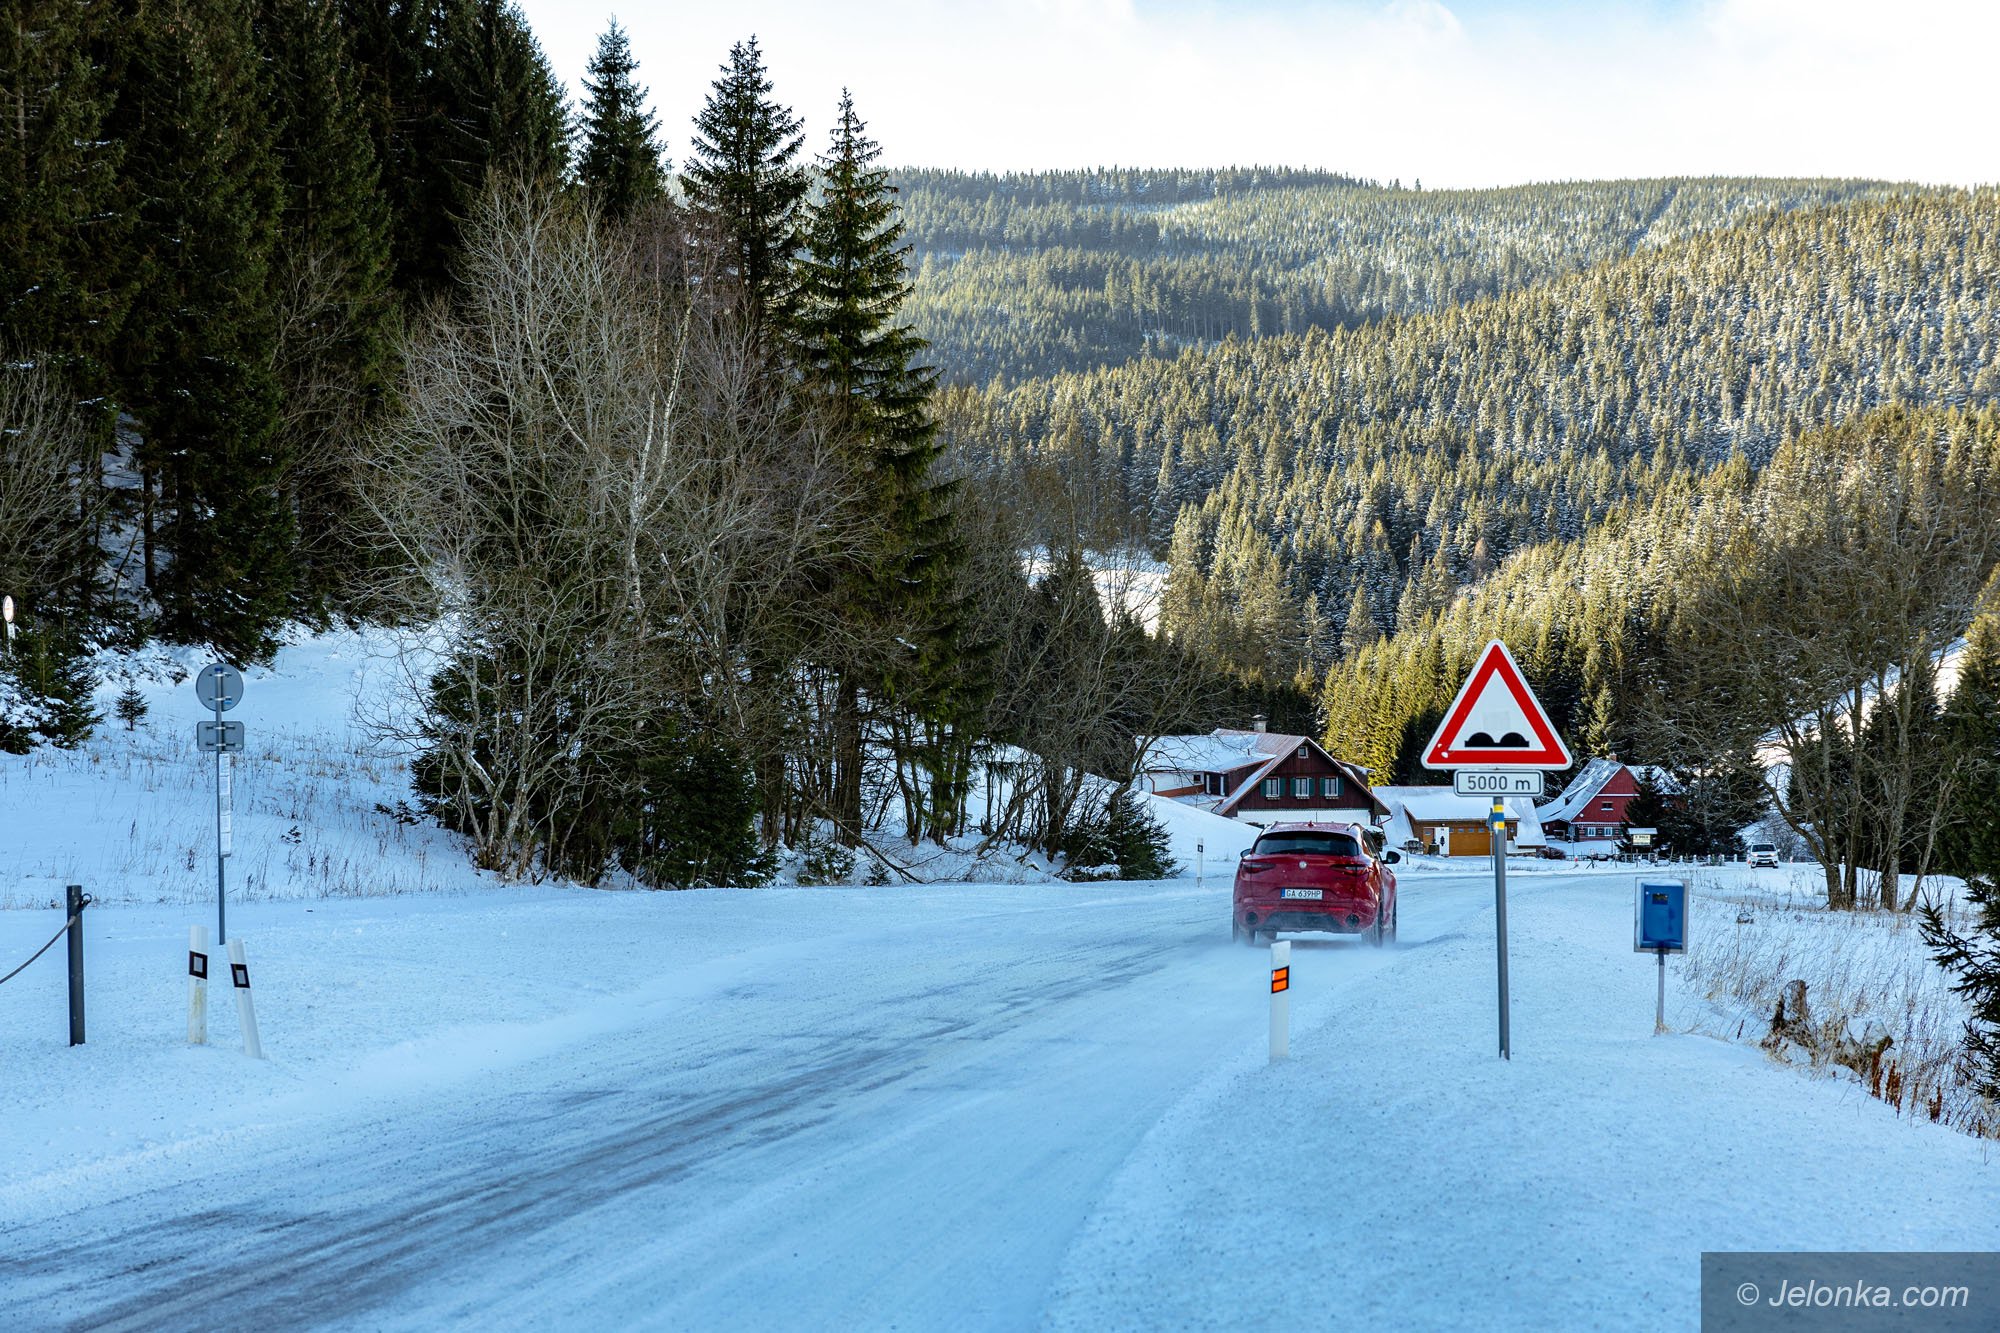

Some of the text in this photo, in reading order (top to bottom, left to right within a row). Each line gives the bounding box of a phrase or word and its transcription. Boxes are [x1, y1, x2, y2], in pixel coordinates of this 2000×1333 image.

[1467, 775, 1531, 791] 5000 m
[1286, 889, 1296, 897] GA
